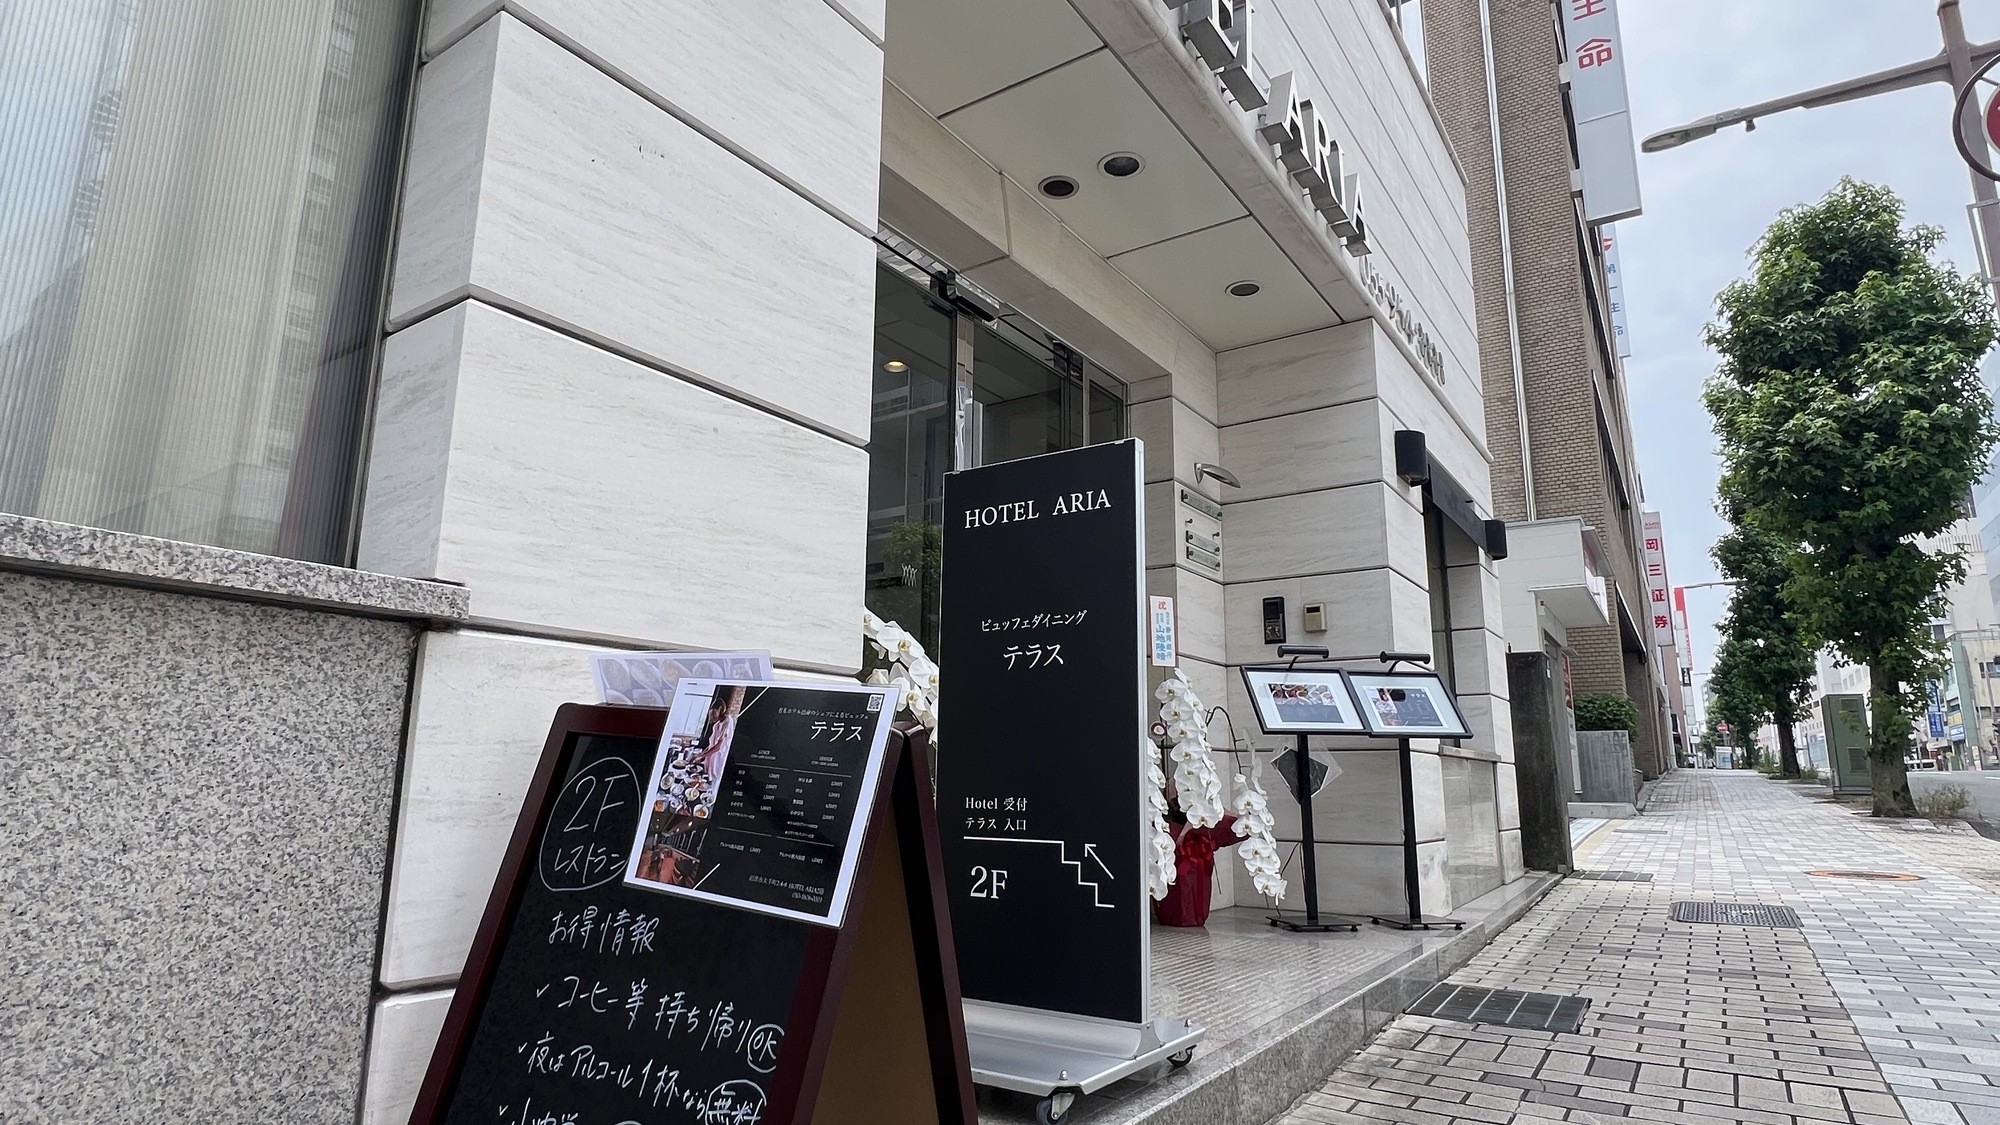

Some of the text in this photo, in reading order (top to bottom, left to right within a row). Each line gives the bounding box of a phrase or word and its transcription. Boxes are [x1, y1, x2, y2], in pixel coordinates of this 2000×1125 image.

[1268, 70, 1372, 255] ARIA
[964, 488, 1112, 529] HOTEL ARIA
[1645, 538, 1669, 629] 岡三証券
[1002, 643, 1064, 671] テラス
[810, 720, 863, 743] テラス
[563, 773, 630, 833] 2F
[965, 797, 1028, 812] Hotel 受付
[965, 817, 1027, 831] テラス 入口
[554, 842, 626, 884] レストラン
[970, 865, 1008, 899] 2F
[548, 905, 660, 957] お得情報
